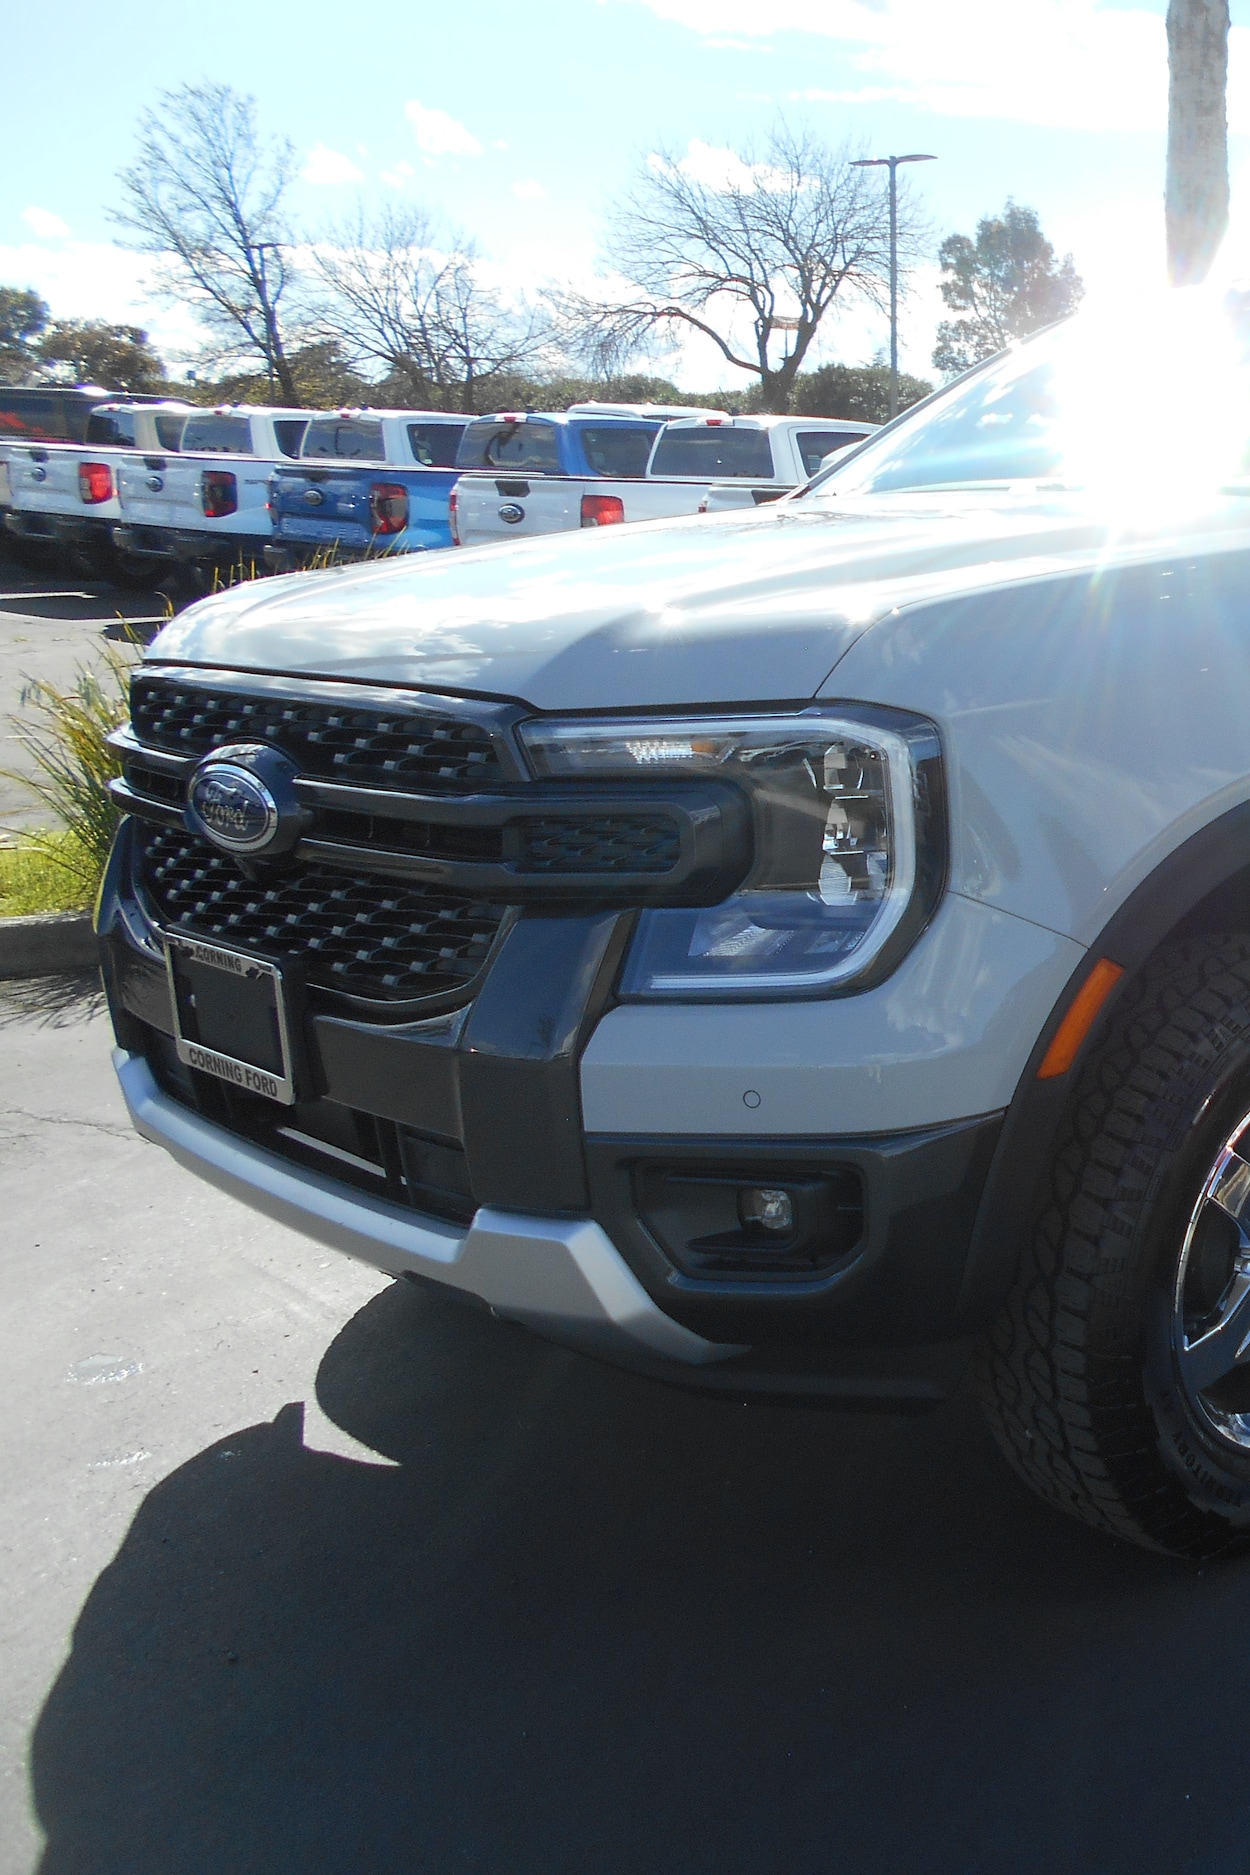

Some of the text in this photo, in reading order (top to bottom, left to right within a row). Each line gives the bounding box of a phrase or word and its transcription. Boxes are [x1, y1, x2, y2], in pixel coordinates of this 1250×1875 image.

[195, 945, 242, 973] CORNING
[189, 1048, 278, 1097] CORNING FORD
